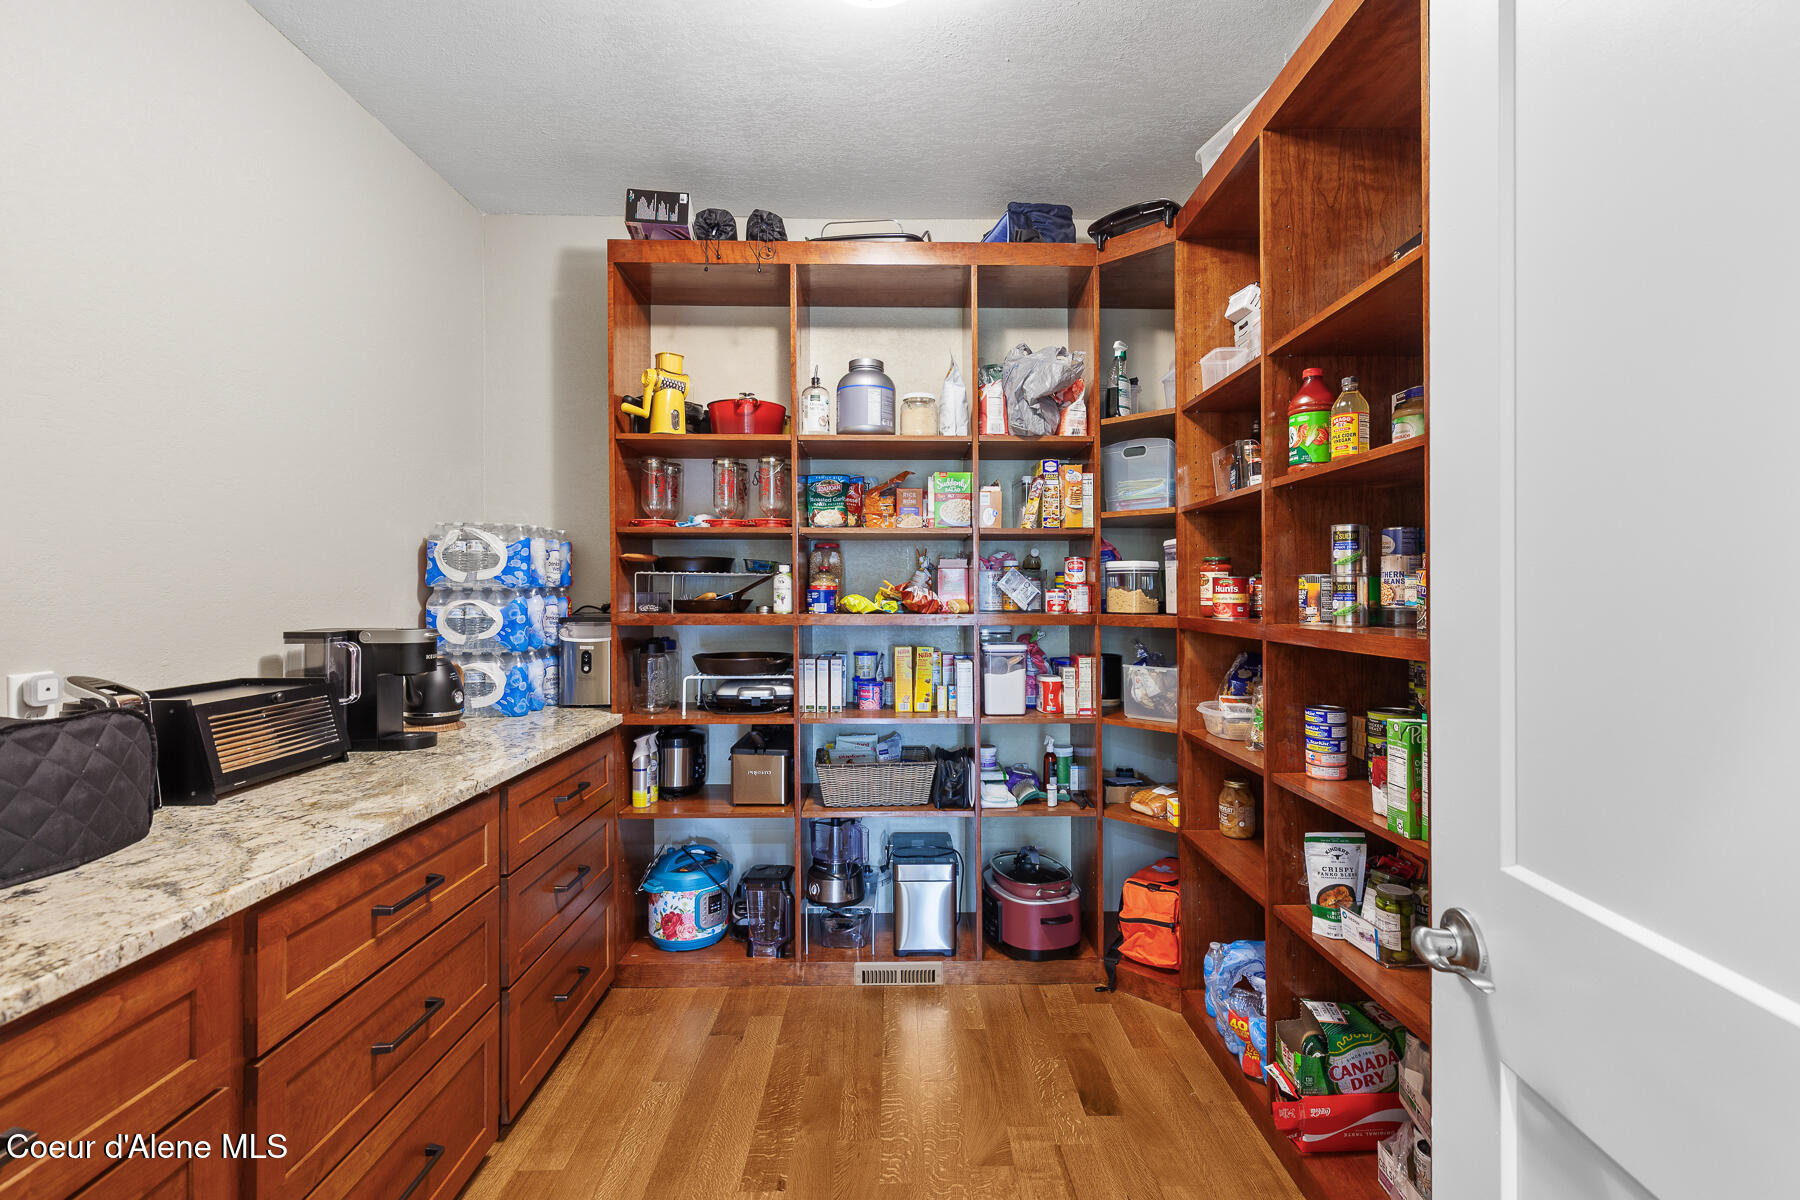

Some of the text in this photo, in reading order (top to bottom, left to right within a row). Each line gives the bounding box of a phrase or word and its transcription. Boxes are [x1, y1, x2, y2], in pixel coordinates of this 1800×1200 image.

[1229, 1018, 1248, 1031] 40
[1329, 1050, 1399, 1082] CANADA
[1350, 1070, 1385, 1091] DRY
